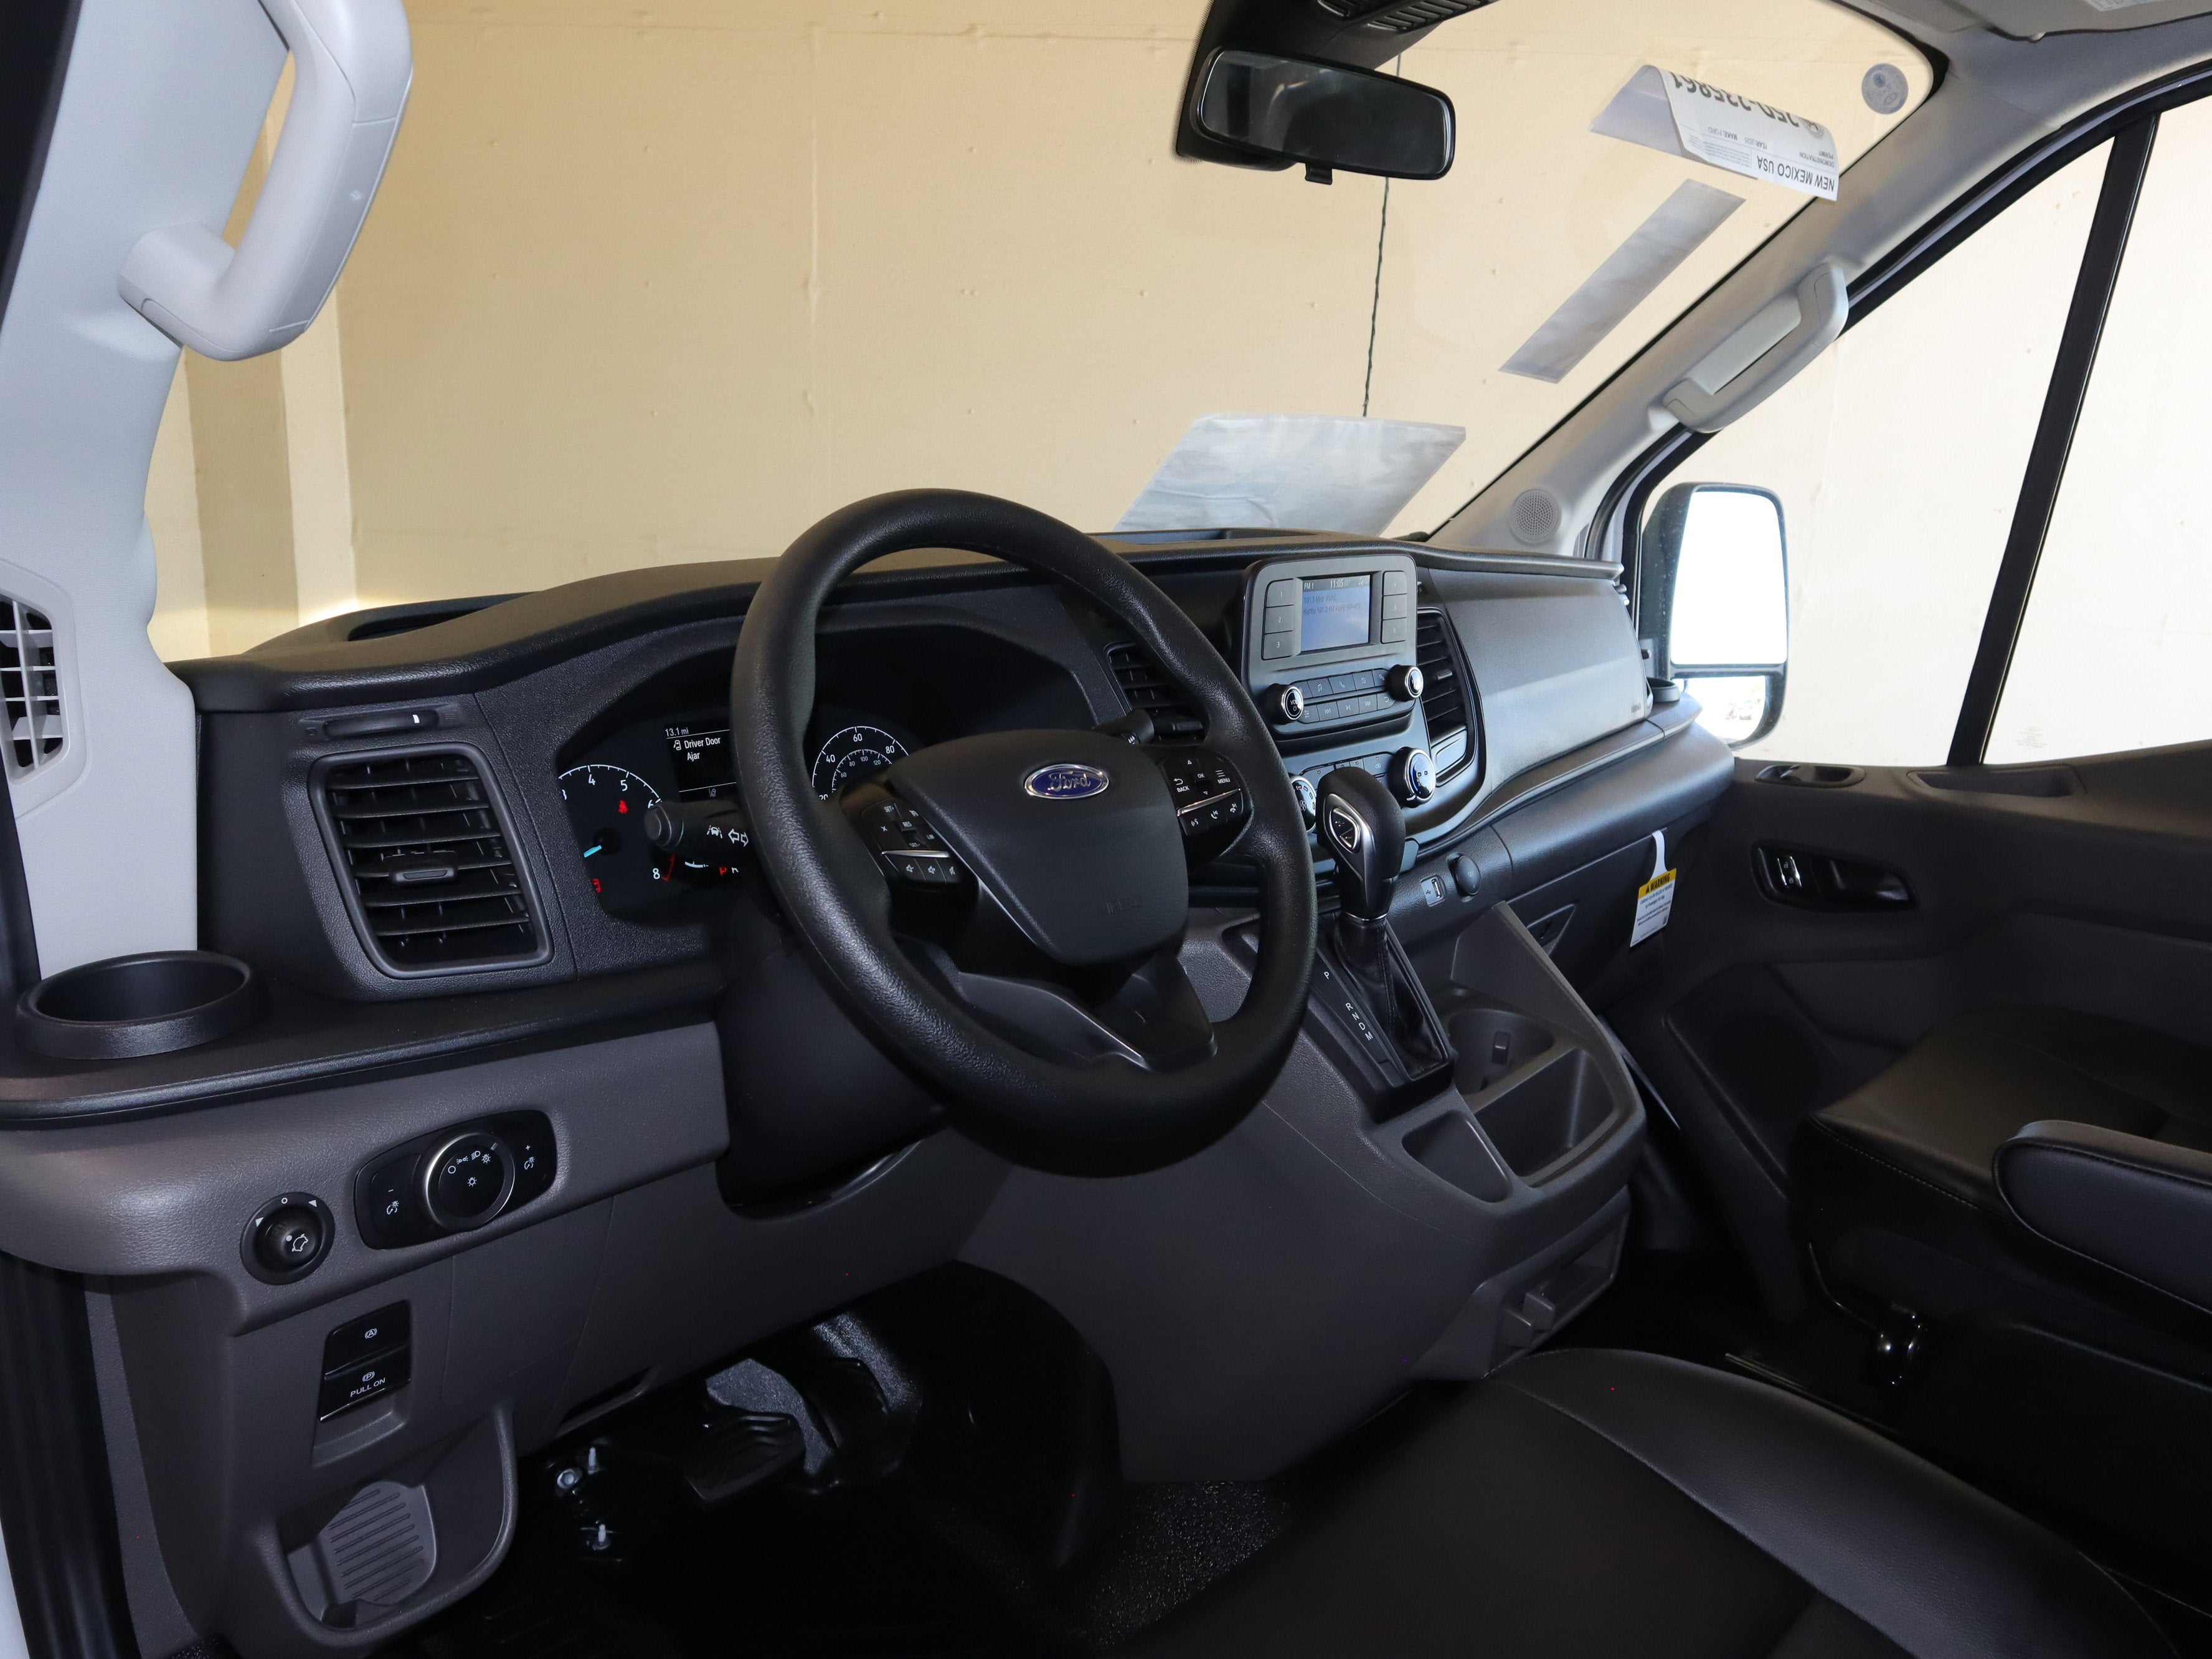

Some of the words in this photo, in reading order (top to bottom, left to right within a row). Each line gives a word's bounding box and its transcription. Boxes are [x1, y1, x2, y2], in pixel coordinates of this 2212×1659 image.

[1708, 126, 1722, 136] FORD
[1799, 151, 1835, 168] DEMONSTRATION
[1819, 151, 1833, 159] PERMIT
[1757, 155, 1774, 174] USA
[1777, 163, 1813, 185] MEXICO
[1814, 174, 1835, 192] NEW
[1330, 579, 1344, 588] 11:05
[665, 728, 679, 737] 13.1
[853, 733, 863, 742] 60
[684, 739, 704, 749] Driver
[706, 737, 721, 746] Door
[885, 745, 895, 754] 80
[687, 752, 700, 762] Ajar
[826, 754, 836, 763] 40
[588, 774, 596, 785] 4
[1047, 771, 1091, 792] Ford
[620, 780, 628, 791] 5
[652, 868, 660, 879] 8
[1650, 872, 1670, 891] WARNING
[1323, 971, 1330, 980] P
[1345, 1002, 1354, 1011] R
[1351, 1011, 1360, 1021] N
[1358, 1022, 1366, 1031] D
[1364, 1031, 1374, 1041] M
[350, 1384, 372, 1397] PULL
[374, 1378, 385, 1387] ON
